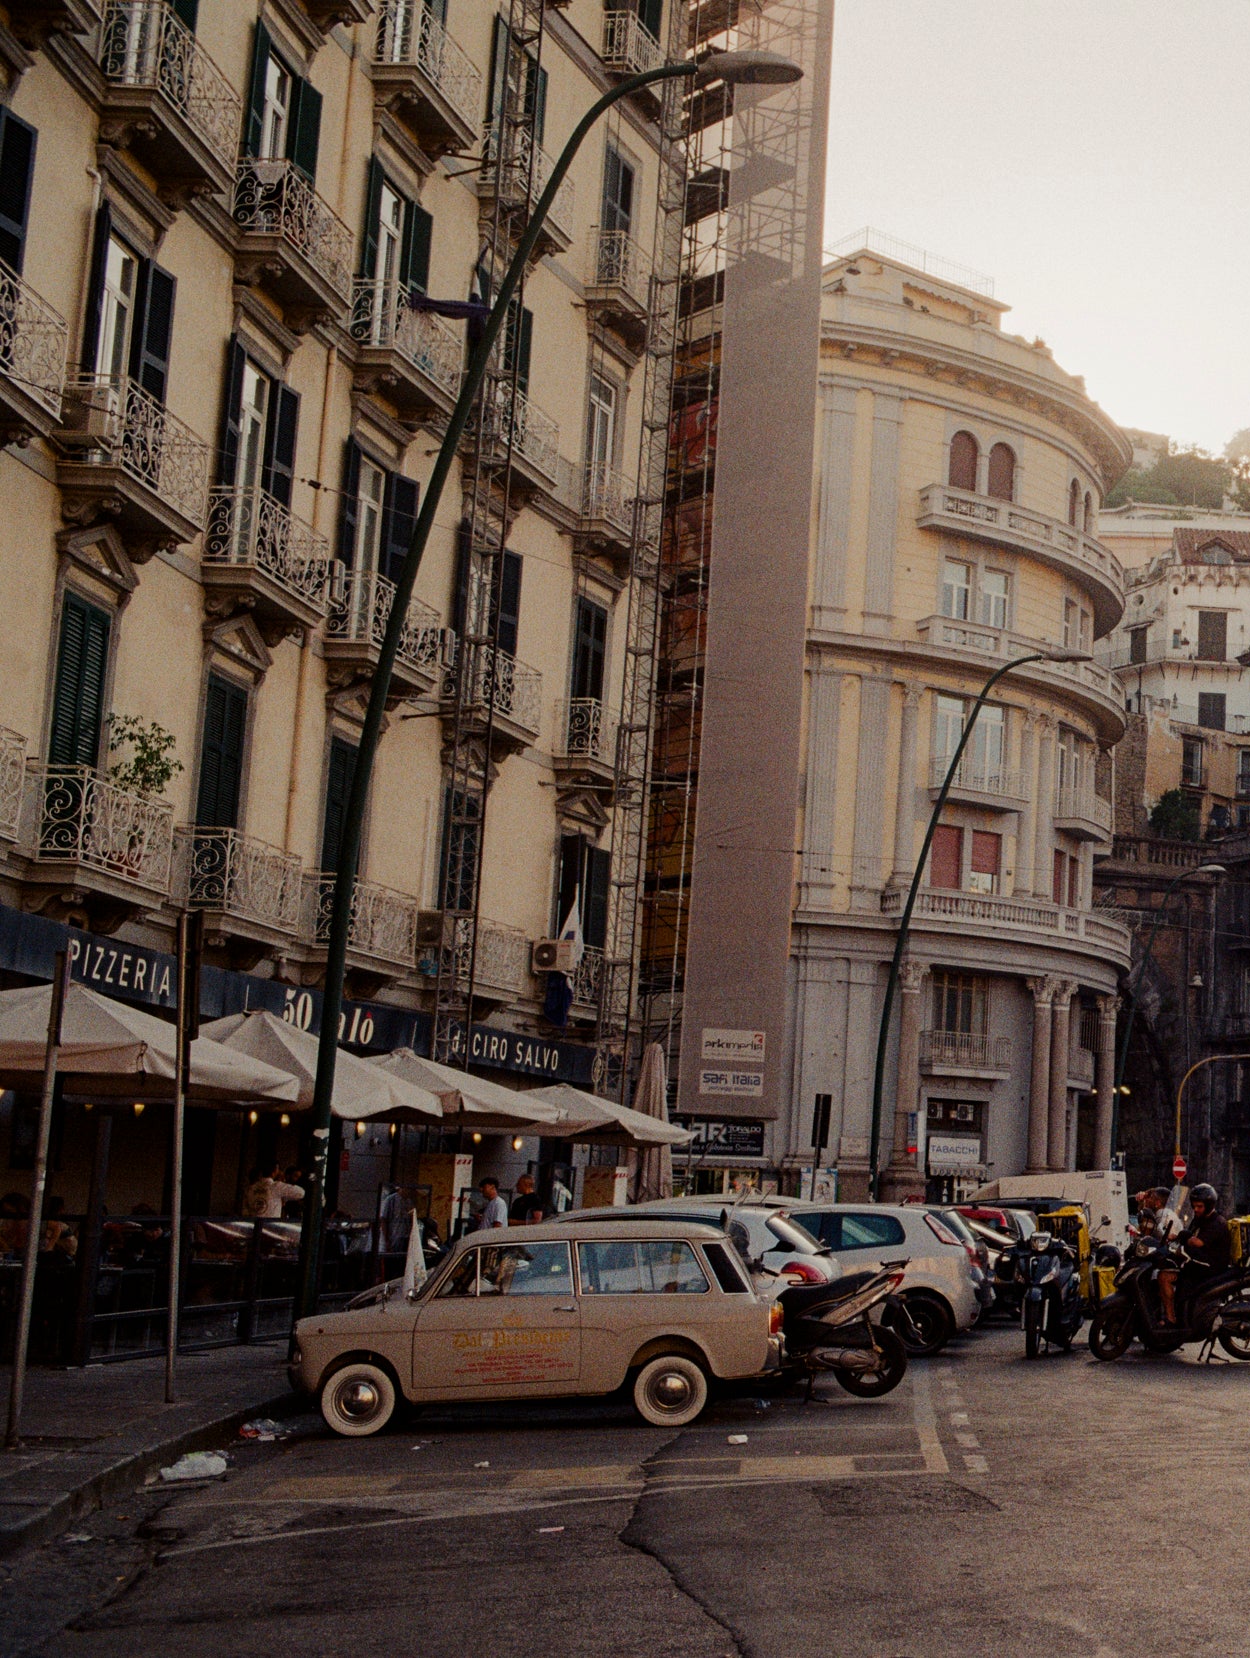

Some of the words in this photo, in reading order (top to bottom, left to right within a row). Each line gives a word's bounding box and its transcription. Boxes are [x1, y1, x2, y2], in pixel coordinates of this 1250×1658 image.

[71, 938, 171, 996] PIZZERIA
[284, 988, 313, 1031] 50
[472, 1032, 508, 1061] CIRO
[516, 1041, 560, 1071] SALVO
[931, 1145, 978, 1155] TABACCHI
